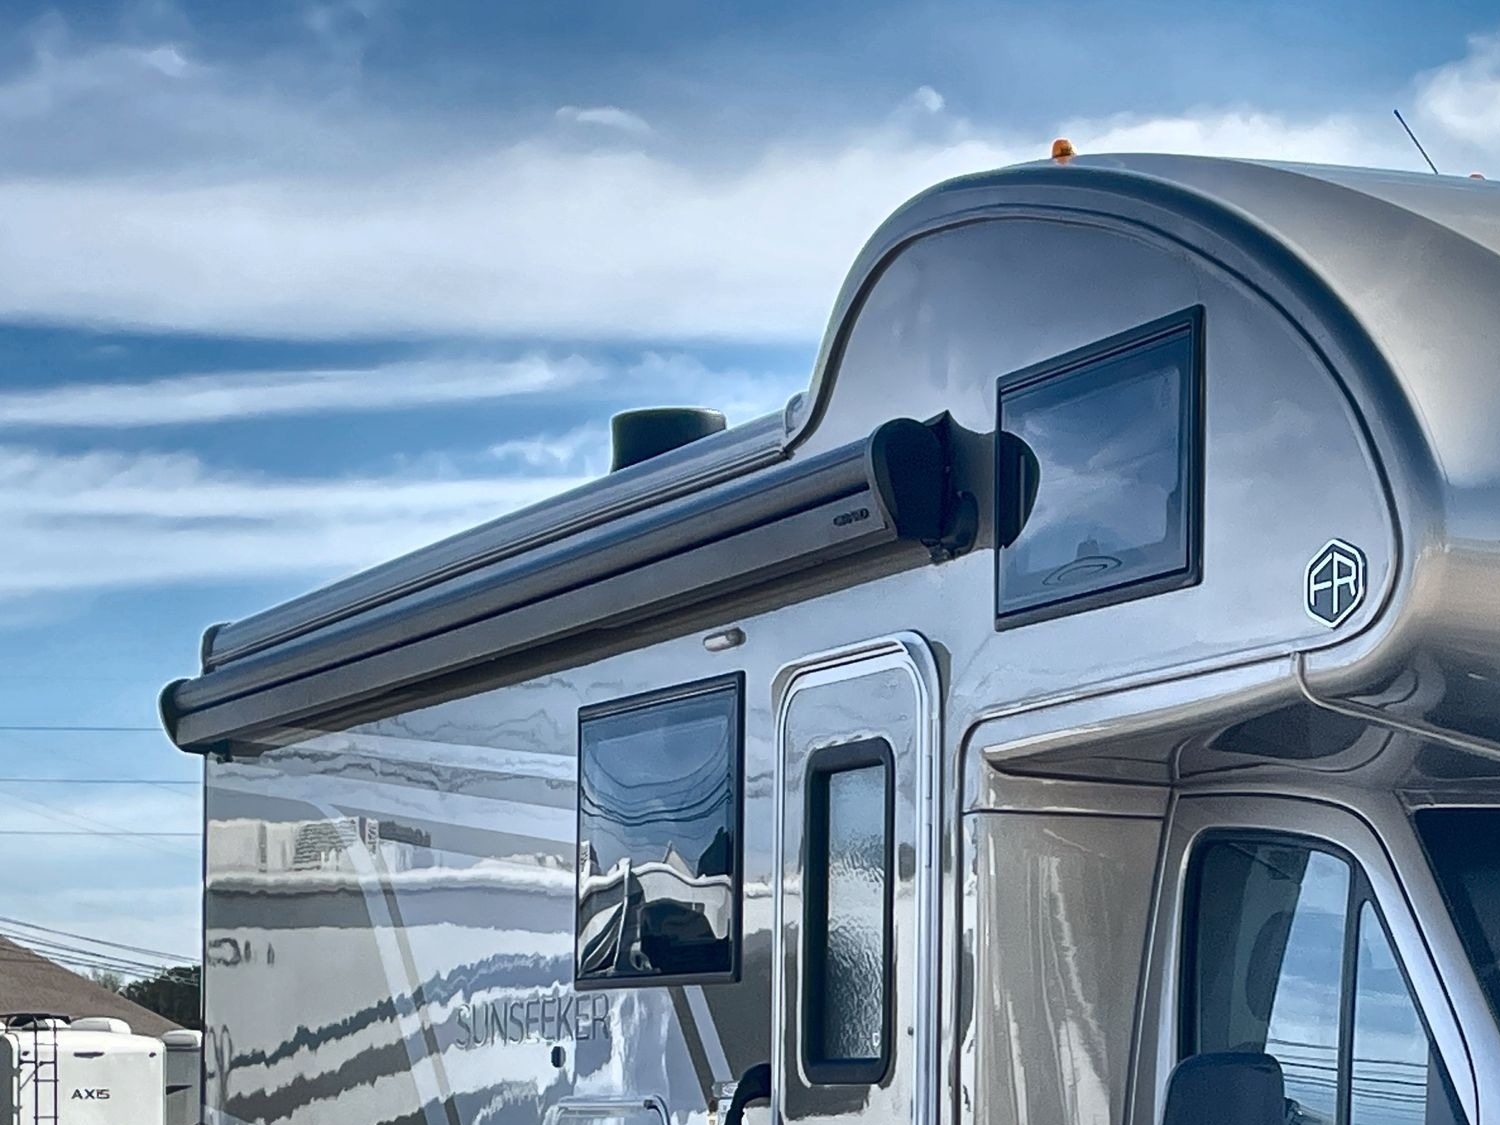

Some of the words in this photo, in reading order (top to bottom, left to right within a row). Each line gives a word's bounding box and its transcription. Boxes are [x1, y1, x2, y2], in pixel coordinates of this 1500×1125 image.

[1308, 549, 1358, 616] FR
[455, 992, 612, 1049] SUNSEEKER
[71, 1088, 111, 1100] AXIS
